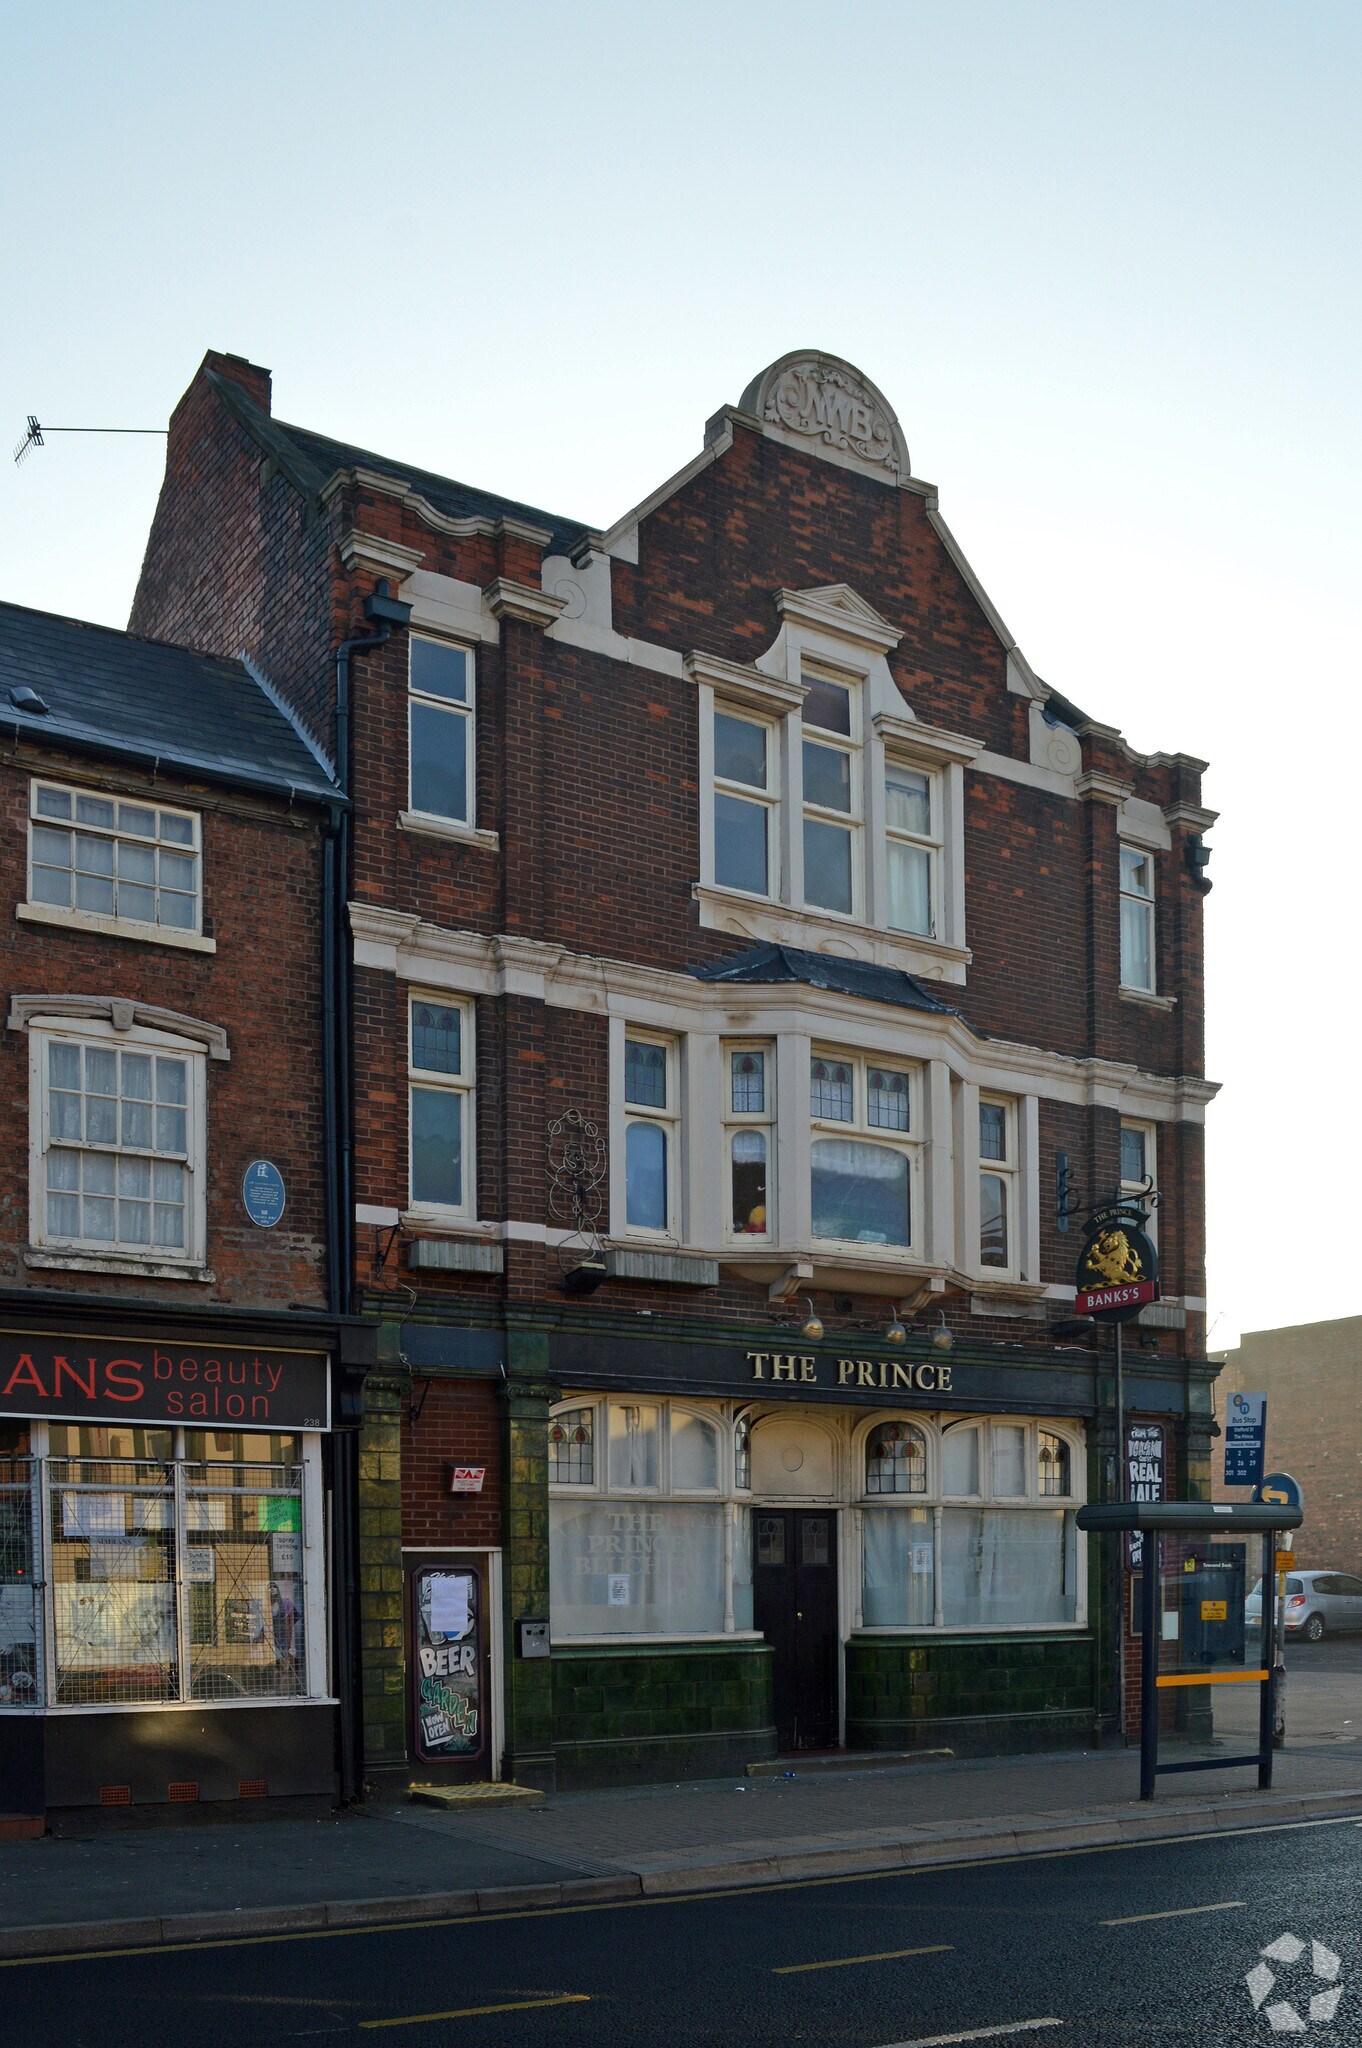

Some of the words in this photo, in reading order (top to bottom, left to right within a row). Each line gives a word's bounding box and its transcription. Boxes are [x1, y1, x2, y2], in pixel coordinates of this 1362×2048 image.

[1094, 1213, 1108, 1223] THE
[1110, 1208, 1133, 1217] PRINCE
[1087, 1288, 1139, 1307] BANKS'S
[1, 1353, 144, 1401] ANS
[154, 1350, 283, 1393] beauty
[746, 1352, 817, 1382] THE
[837, 1359, 953, 1391] PRINCE
[167, 1387, 269, 1418] salon
[304, 1419, 320, 1427] 238
[1147, 1427, 1160, 1437] THE
[1129, 1461, 1162, 1482] REAL
[1136, 1484, 1161, 1502] ALE
[608, 1513, 665, 1531] THE
[588, 1535, 684, 1553] PRINCE
[575, 1557, 692, 1575] BLUCH
[419, 1645, 476, 1678] BEER
[420, 1677, 478, 1736] GARDEN
[425, 1713, 445, 1727] NOW
[428, 1719, 451, 1739] OPEN
